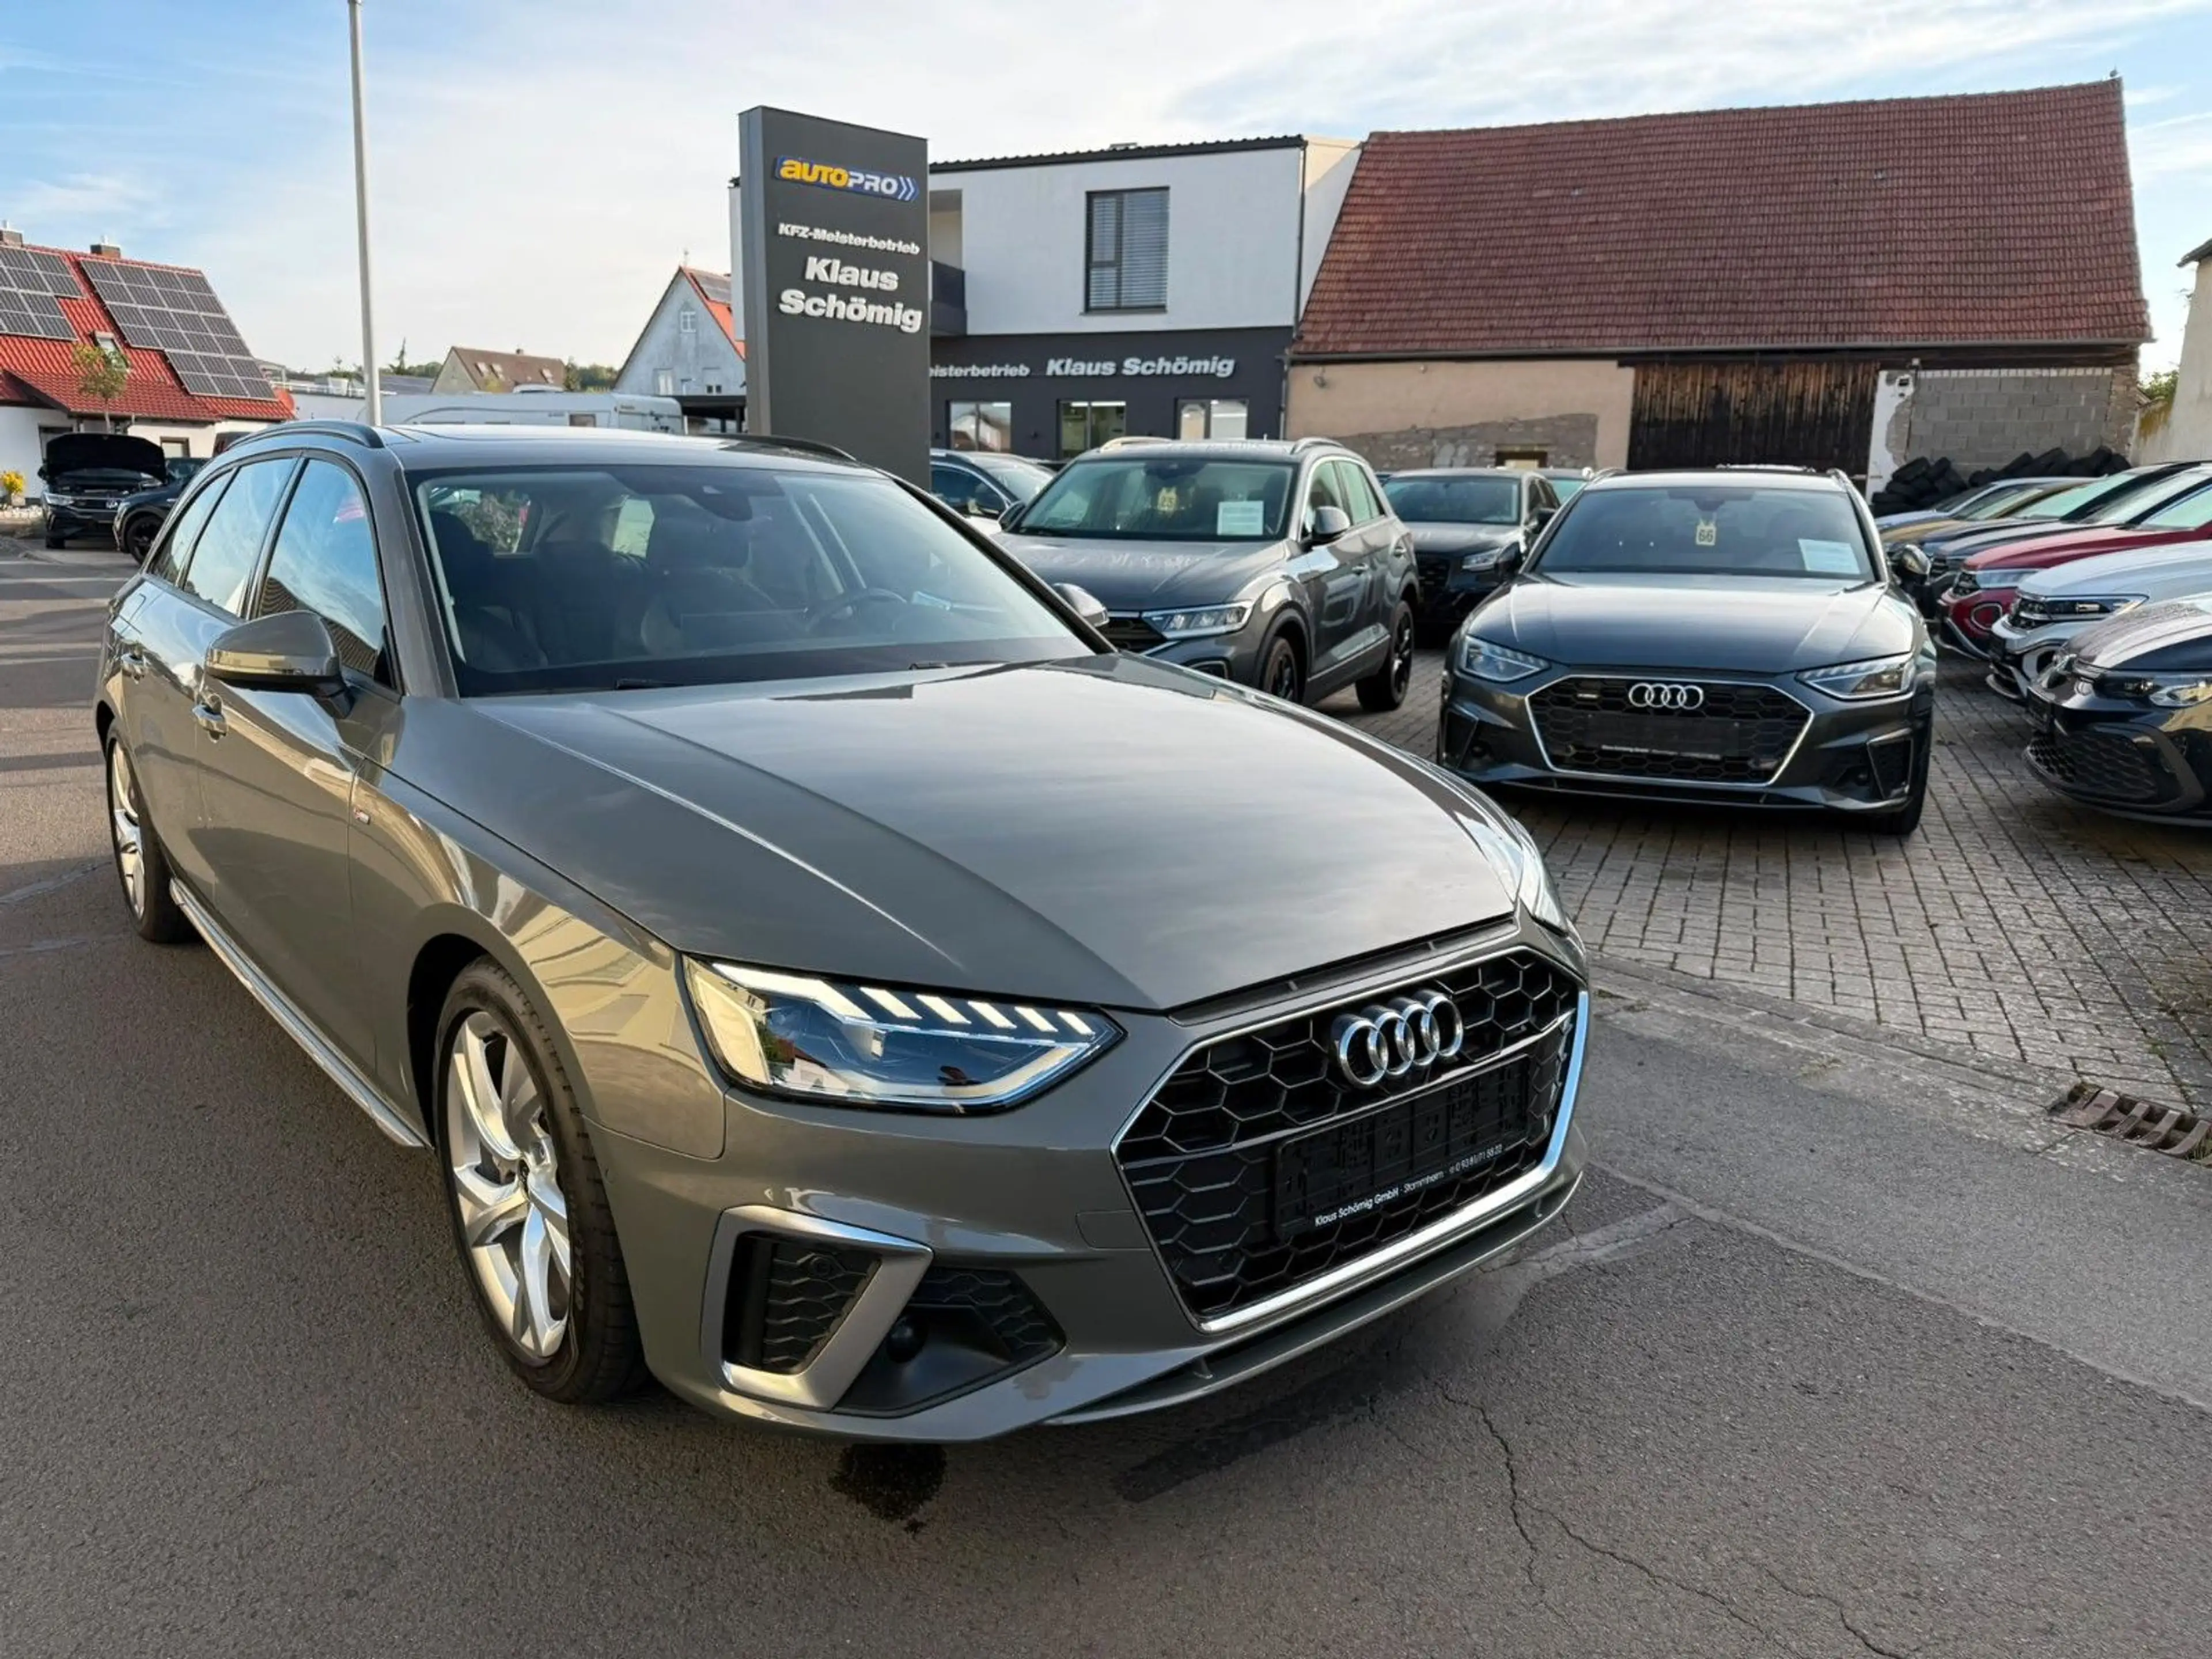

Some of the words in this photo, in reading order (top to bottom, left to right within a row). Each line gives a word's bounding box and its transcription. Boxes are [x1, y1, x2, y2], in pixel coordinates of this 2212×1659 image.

[778, 223, 920, 255] KFZ-Meisterbetrieb
[805, 256, 900, 291] Klaus
[778, 289, 922, 334] Schömig
[1046, 358, 1116, 376] Klaus
[1122, 355, 1235, 377] Schömig
[1315, 1211, 1338, 1227] Klaus
[1338, 1197, 1373, 1218] Schömig
[1374, 1187, 1399, 1205] GmbH
